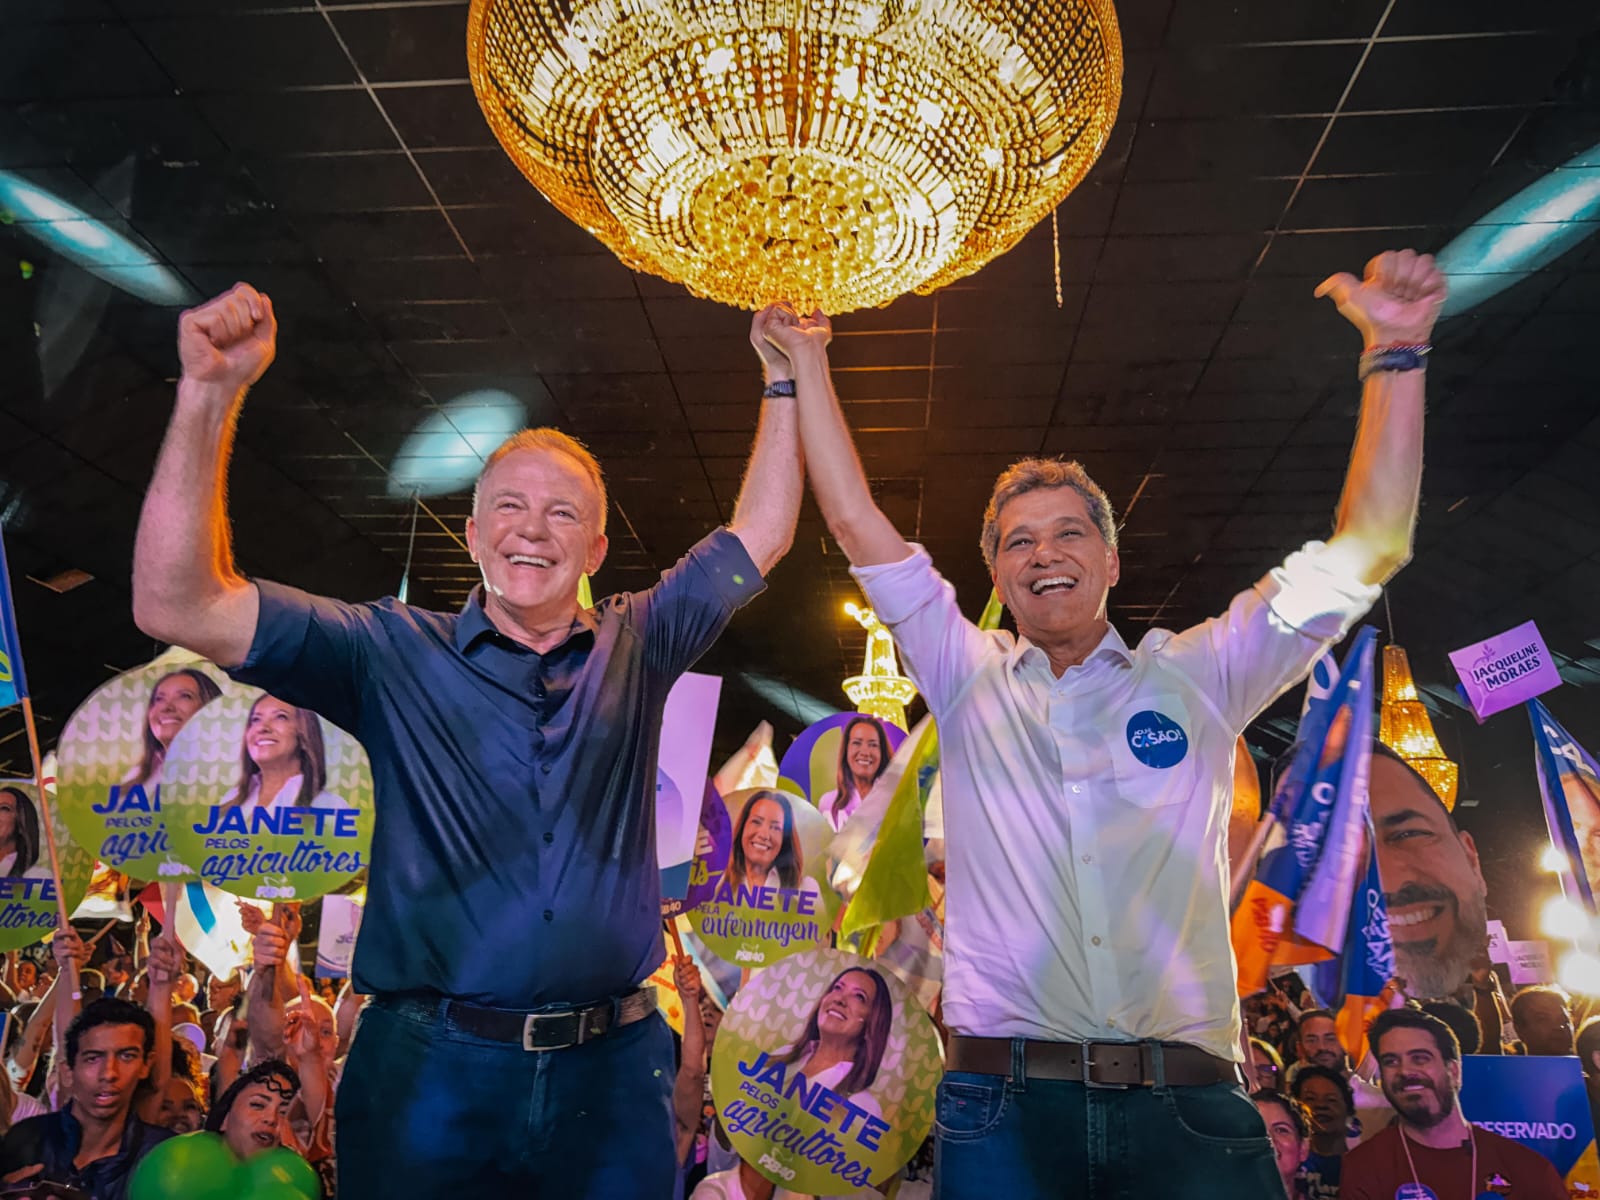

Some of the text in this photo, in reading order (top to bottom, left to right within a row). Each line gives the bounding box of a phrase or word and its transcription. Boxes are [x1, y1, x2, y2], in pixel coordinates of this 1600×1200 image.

[1473, 642, 1540, 681] JACQUELINE
[1486, 655, 1541, 688] MORAES
[105, 815, 153, 829] PELOS
[192, 805, 360, 837] JANETE
[204, 838, 250, 849] PELOS
[200, 839, 368, 887] agricultores
[701, 911, 822, 947] enfermagem
[737, 1052, 891, 1152] JANETE
[739, 1081, 780, 1110] PELOS
[723, 1099, 873, 1188] agricultores
[1472, 1121, 1577, 1140] ESERVADO
